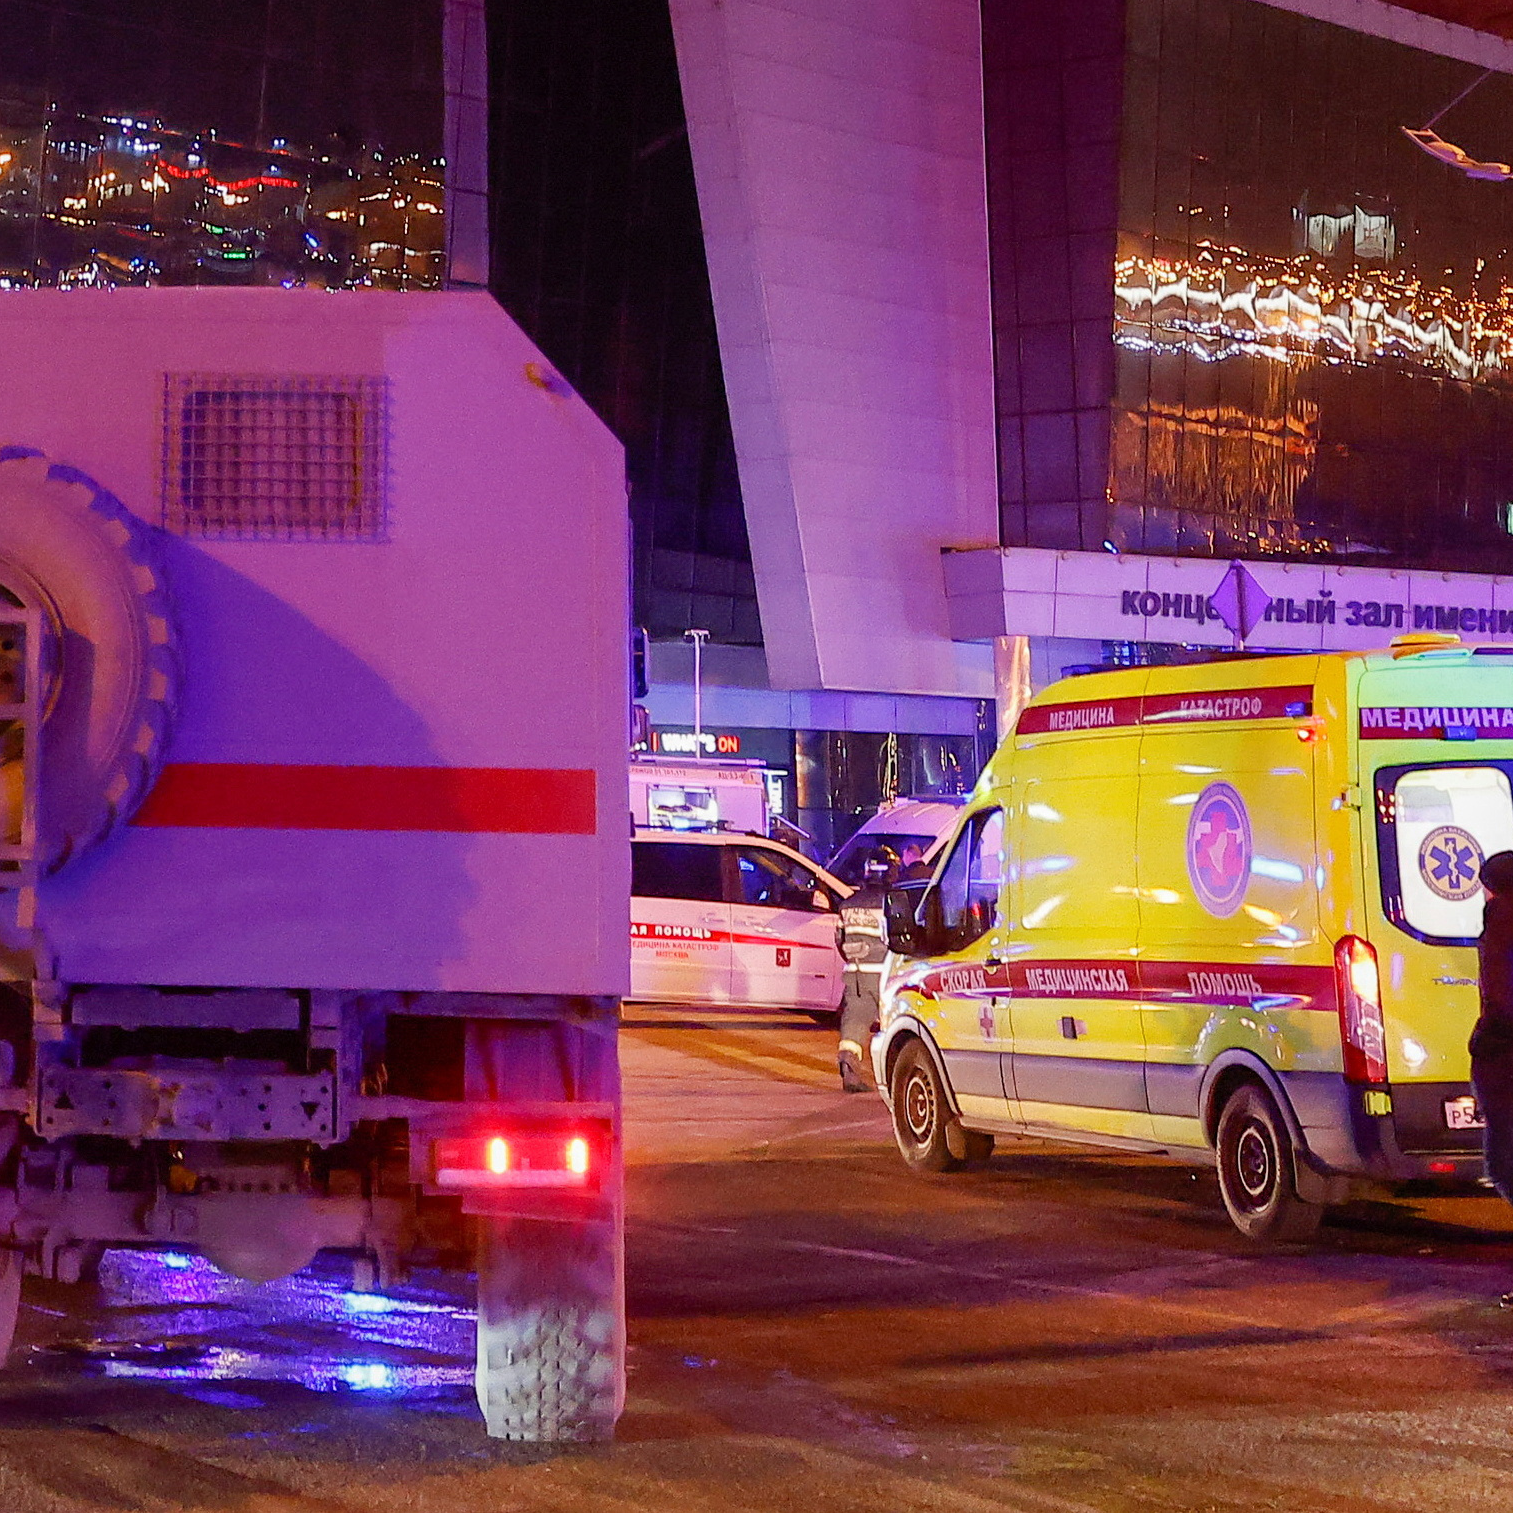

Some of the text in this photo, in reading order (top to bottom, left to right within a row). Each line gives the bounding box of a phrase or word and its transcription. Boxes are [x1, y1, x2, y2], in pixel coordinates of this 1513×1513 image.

[1121, 589, 1336, 626] концный
[1049, 696, 1262, 731] МЕДИЦИНА КАТАСТРОФ
[717, 735, 740, 753] ON
[630, 924, 712, 940] АЯ ПОМОЩЬ
[632, 941, 720, 951] ЕДИЦИНА КАТАСТРОФ
[939, 968, 1263, 998] СКОРАЯ МЕДИЦИНСКАЯ ПОМОЩЬ
[1451, 1106, 1486, 1125] Р5
